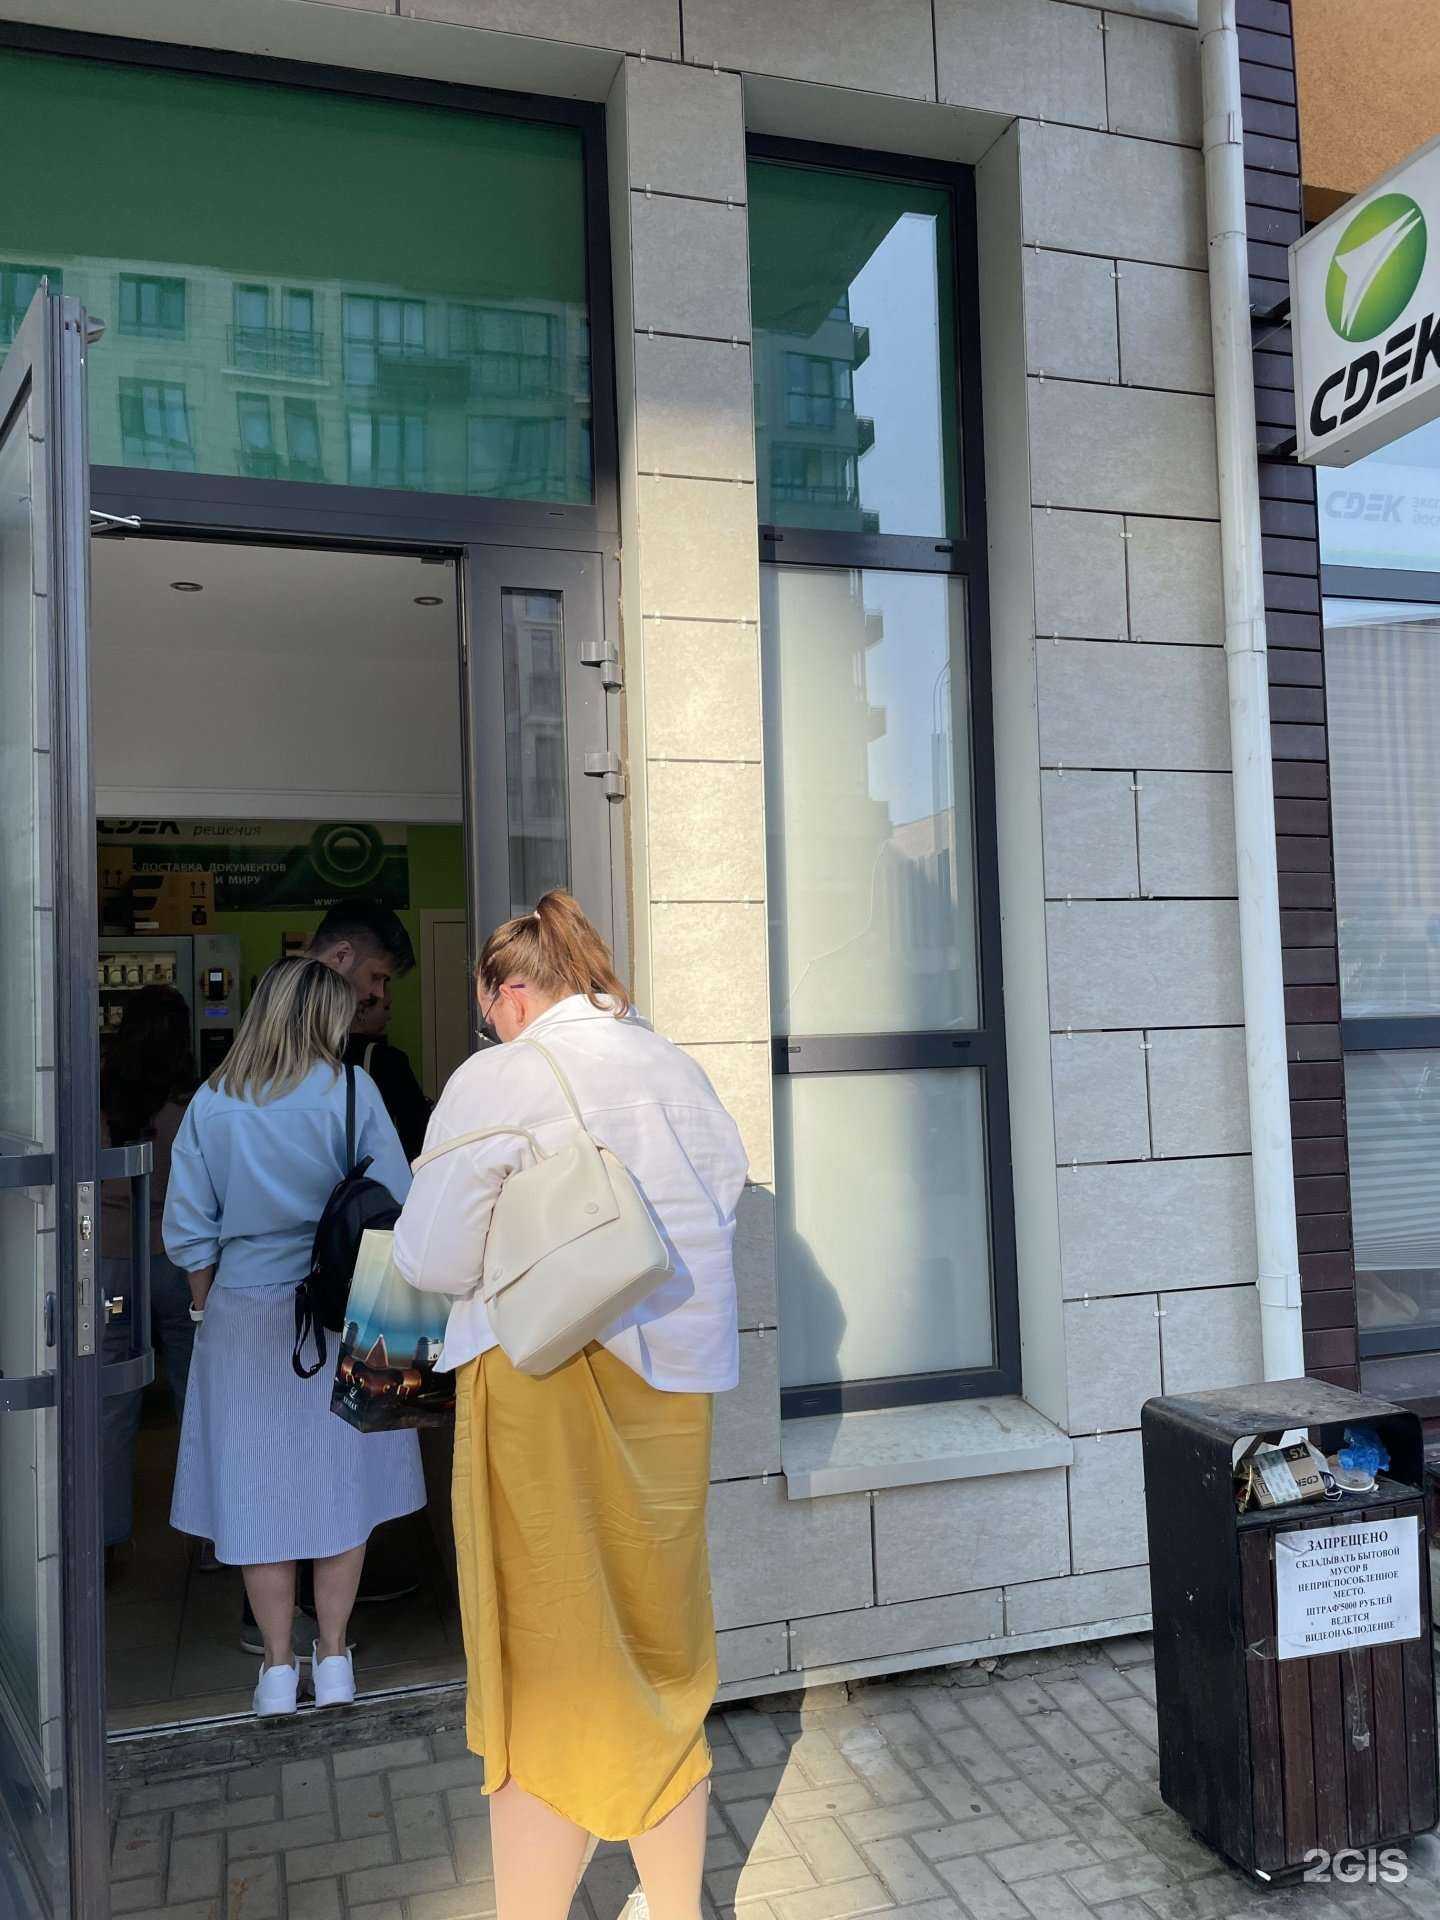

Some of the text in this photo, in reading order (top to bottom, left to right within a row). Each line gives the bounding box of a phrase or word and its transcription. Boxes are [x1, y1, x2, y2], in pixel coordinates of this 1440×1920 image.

[1310, 312, 1440, 437] CDEK
[1325, 490, 1406, 523] CDEK
[193, 824, 263, 837] решения
[141, 862, 204, 873] ДОСТАВКА
[208, 862, 287, 874] ДОКУМЕНТОВ
[228, 875, 263, 886] МИРУ
[1307, 1530, 1388, 1551] ЗАПРЕЩЕНО
[1295, 1547, 1400, 1569] СКЛАДЫВАТЬ БЫТОВОЙ
[1330, 1563, 1368, 1576] МУСОР В
[1298, 1570, 1399, 1592] НЕПРИСПОСОБЛЕННОЕ
[1306, 1604, 1340, 1616] ШТРАФ
[1359, 1596, 1392, 1608] РУБЛЕЙ
[1331, 1613, 1369, 1626] ВЕДЕТСЯ
[1305, 1621, 1396, 1643] ВИДЕОНАБЛЮДЕНИЕ
